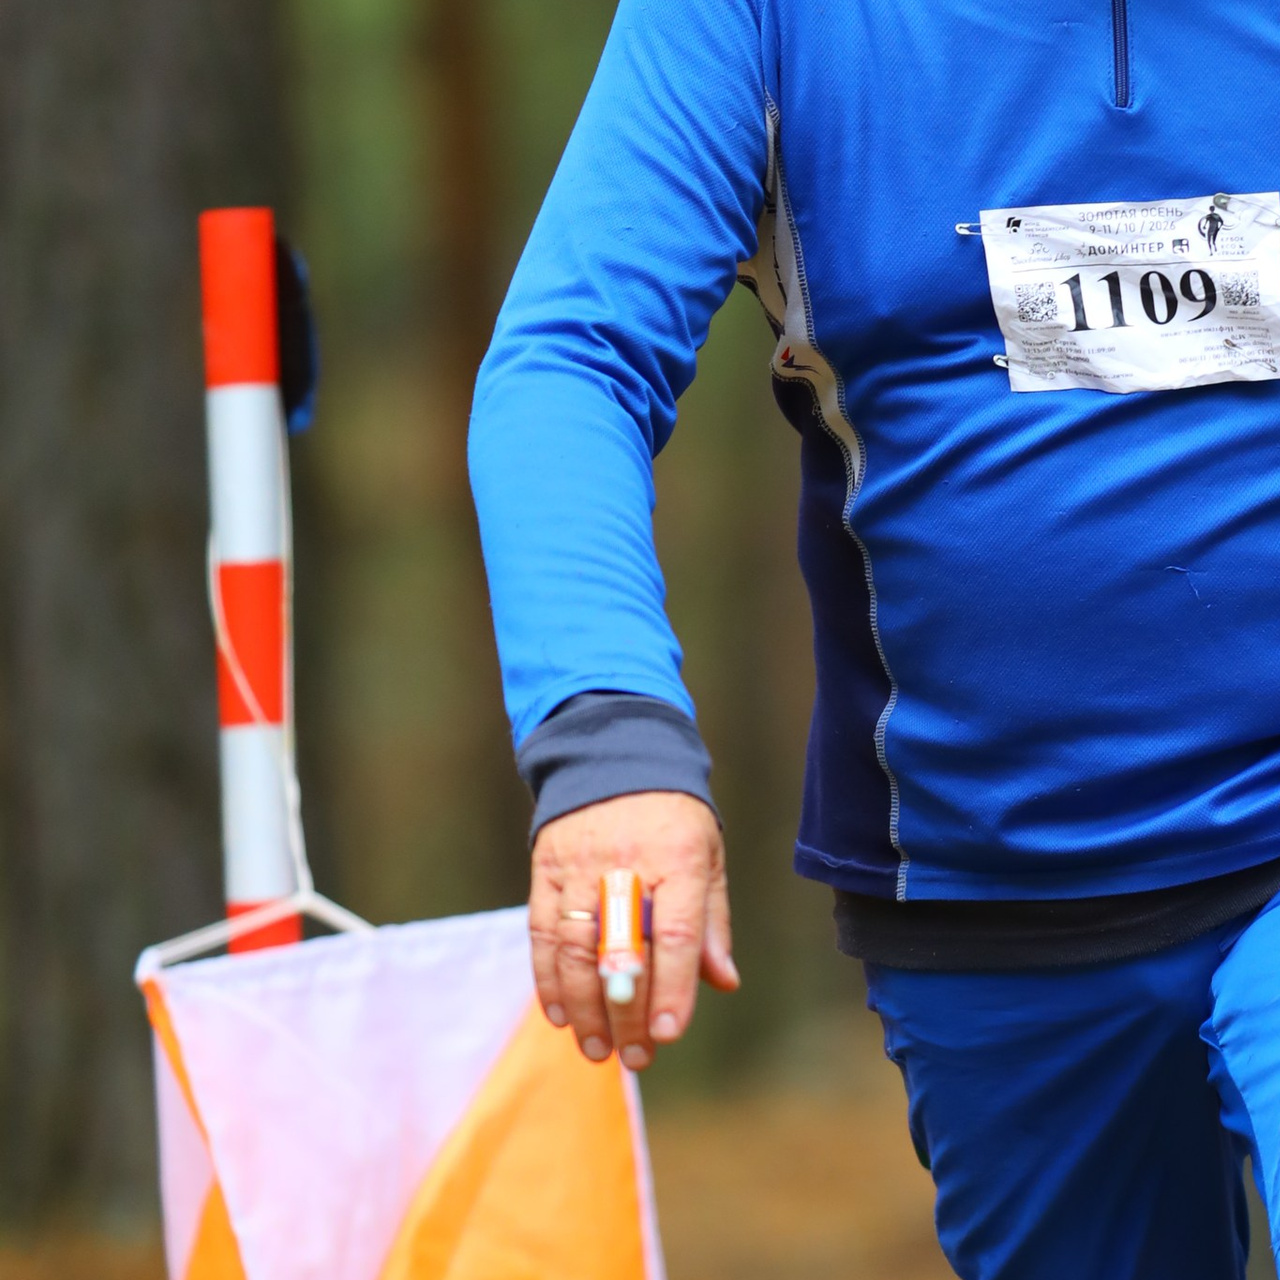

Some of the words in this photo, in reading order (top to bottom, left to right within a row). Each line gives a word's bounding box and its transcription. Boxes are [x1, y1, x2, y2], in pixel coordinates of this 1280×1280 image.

[1078, 208, 1137, 222] ЗОЛОТАЯ
[1140, 206, 1184, 218] ОСЕНЬ
[1124, 222, 1136, 233] 10
[1149, 220, 1177, 232] 2026
[1087, 241, 1165, 257] ДОМИНТЕР
[1060, 268, 1218, 333] 1109
